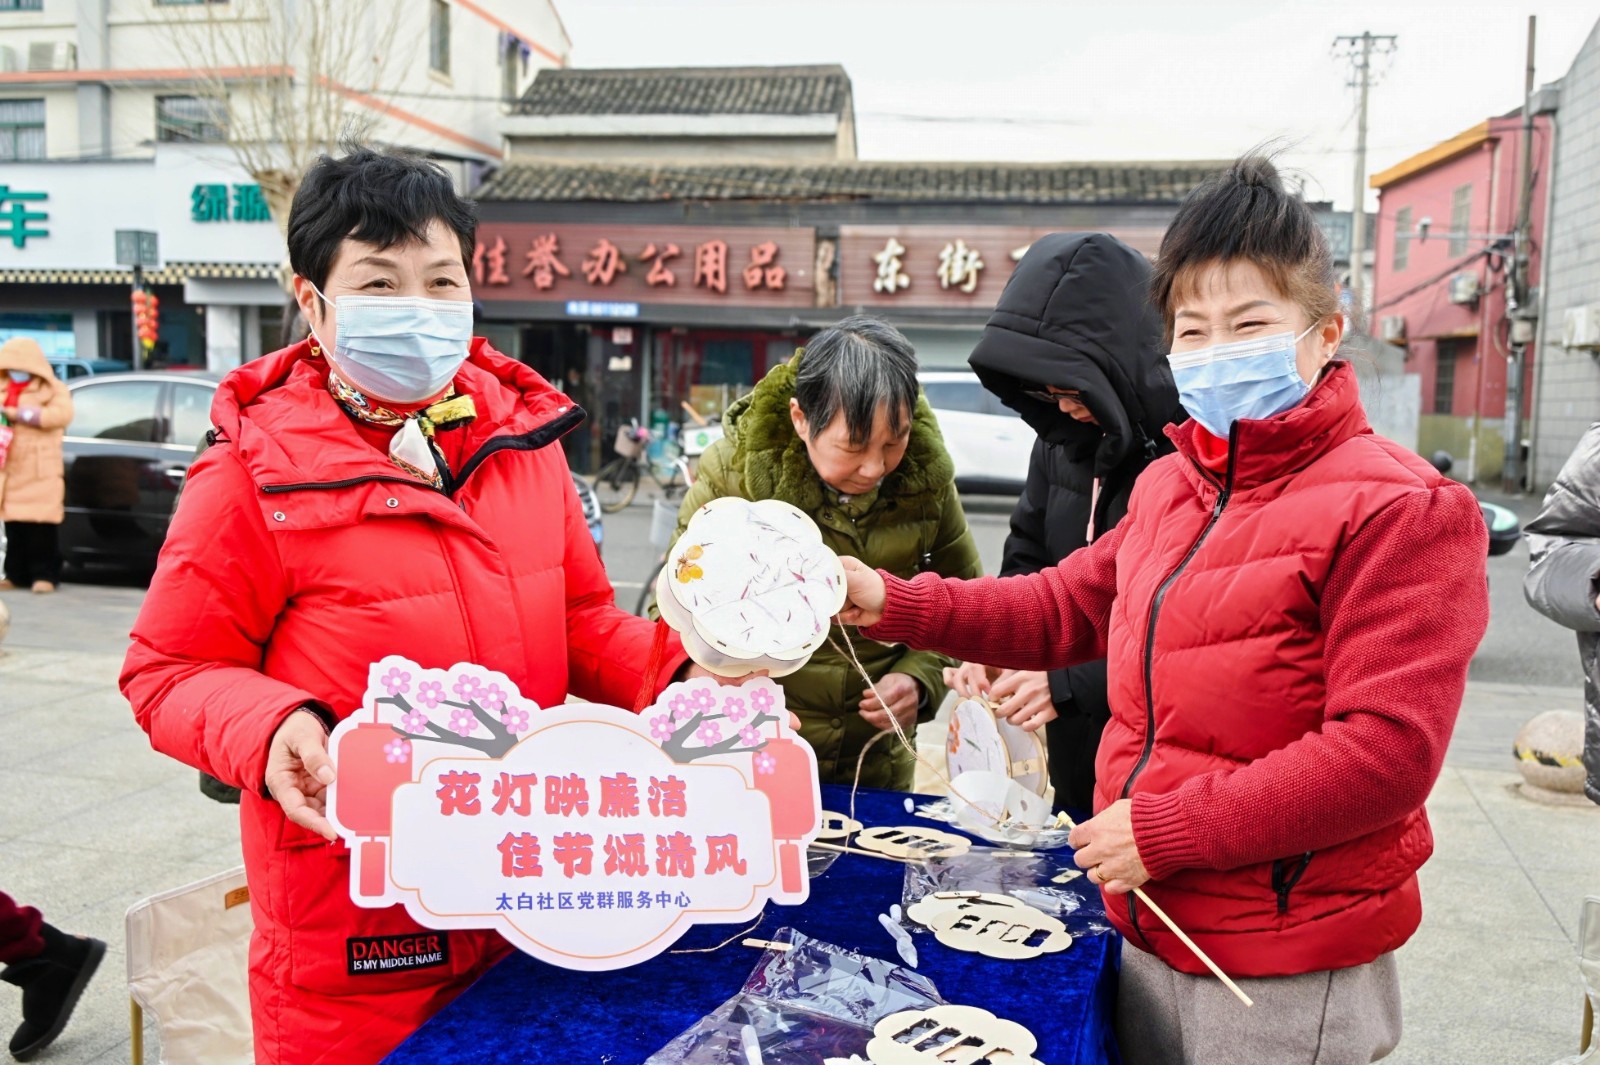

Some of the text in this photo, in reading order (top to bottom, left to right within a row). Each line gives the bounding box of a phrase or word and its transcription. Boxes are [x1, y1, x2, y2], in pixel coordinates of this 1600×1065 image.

[191, 183, 272, 222] 绿源
[472, 232, 787, 293] 佳誉办公用品
[871, 237, 1031, 294] 东街
[435, 770, 687, 817] 花灯映廉洁
[497, 831, 748, 878] 佳节颂清风
[495, 890, 692, 911] 太白社区党群服务中心
[352, 936, 441, 959] DANGER
[353, 952, 442, 970] IS MY MIDDLE NAME
